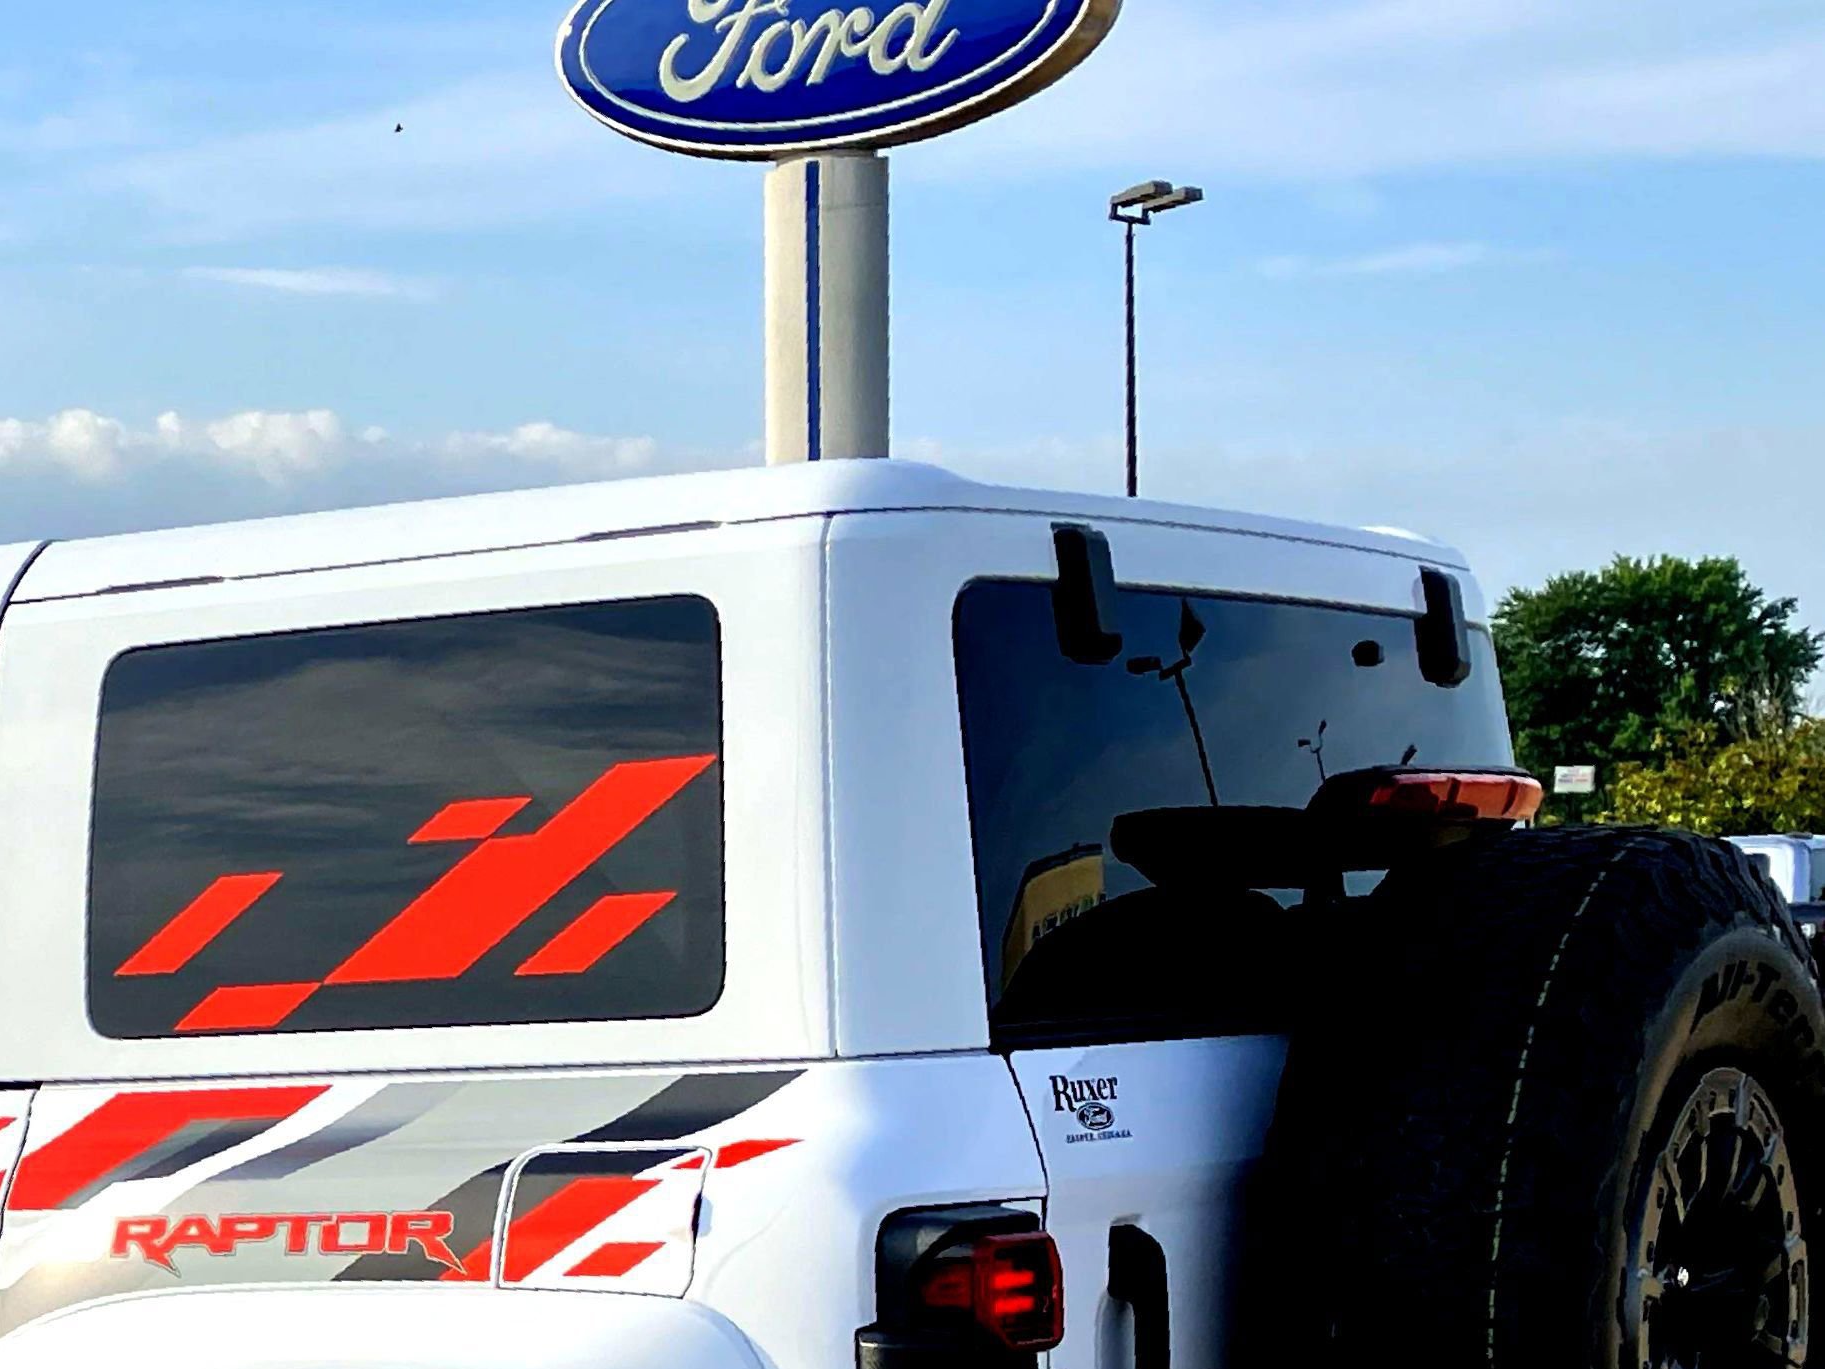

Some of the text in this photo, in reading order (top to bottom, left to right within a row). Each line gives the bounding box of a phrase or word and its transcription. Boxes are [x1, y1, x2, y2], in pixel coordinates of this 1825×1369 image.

[659, 0, 961, 103] Ford
[1048, 1074, 1118, 1113] Ruxer
[109, 1209, 468, 1279] RAPTOR
